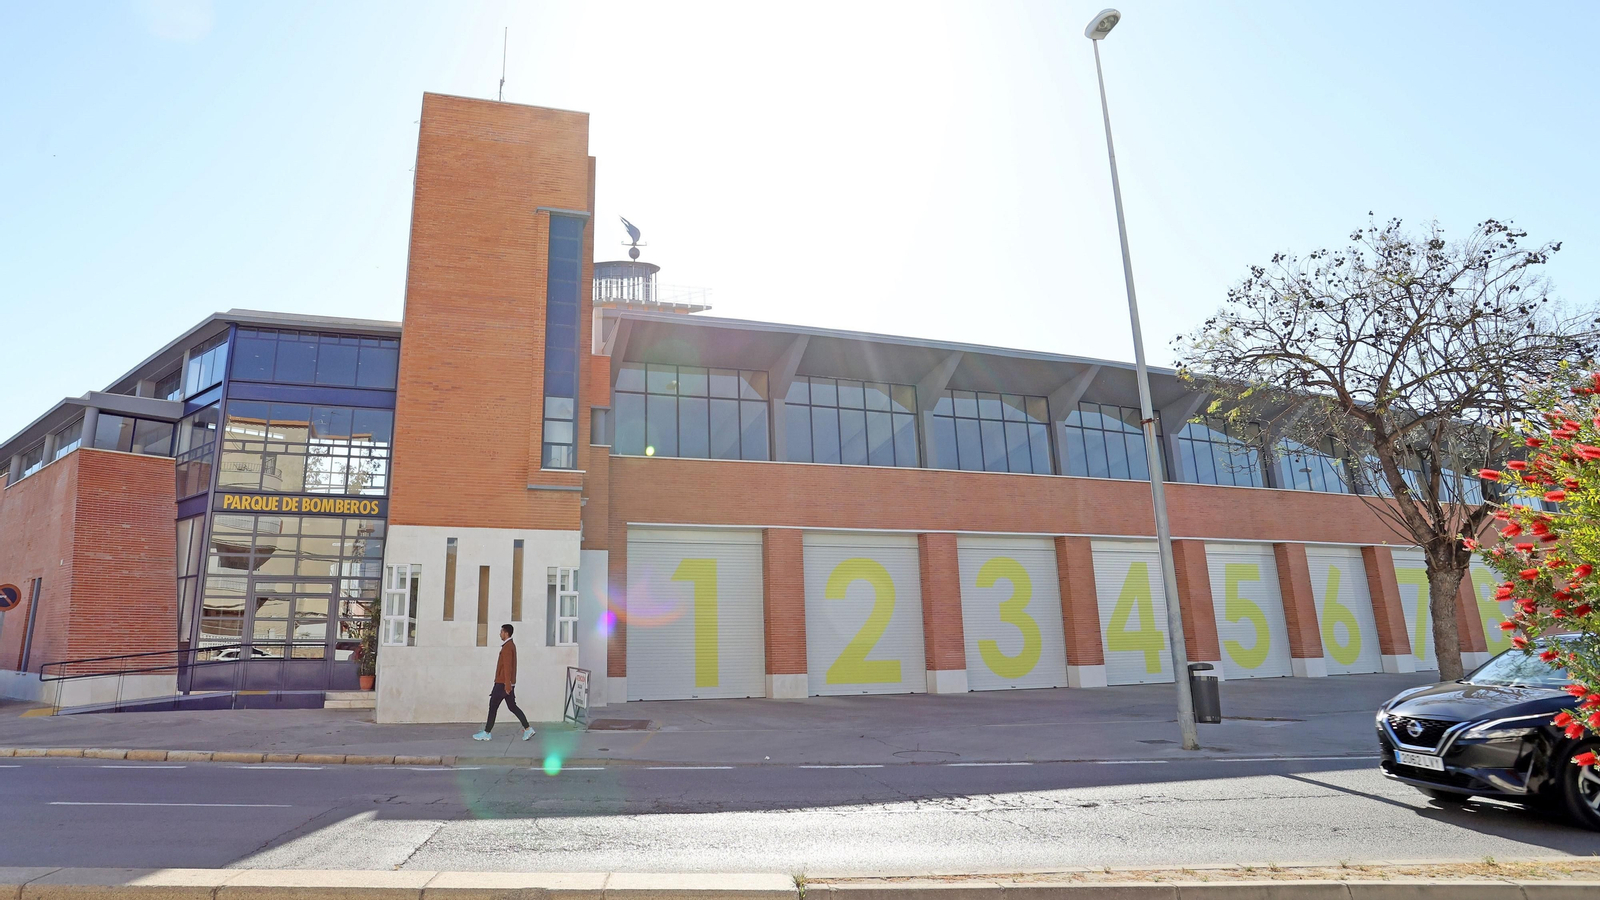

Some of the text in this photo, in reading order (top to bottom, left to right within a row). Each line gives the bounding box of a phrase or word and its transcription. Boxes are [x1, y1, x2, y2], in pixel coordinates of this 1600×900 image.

[223, 494, 379, 515] PARQUE DE BOMBEROS
[671, 558, 719, 688] 1
[825, 557, 901, 685] 2
[975, 557, 1042, 679] 3
[1106, 561, 1165, 674] 4
[1224, 563, 1270, 669] 5
[1321, 565, 1361, 665] 6
[1394, 567, 1430, 662] 7
[1471, 567, 1512, 657] 8
